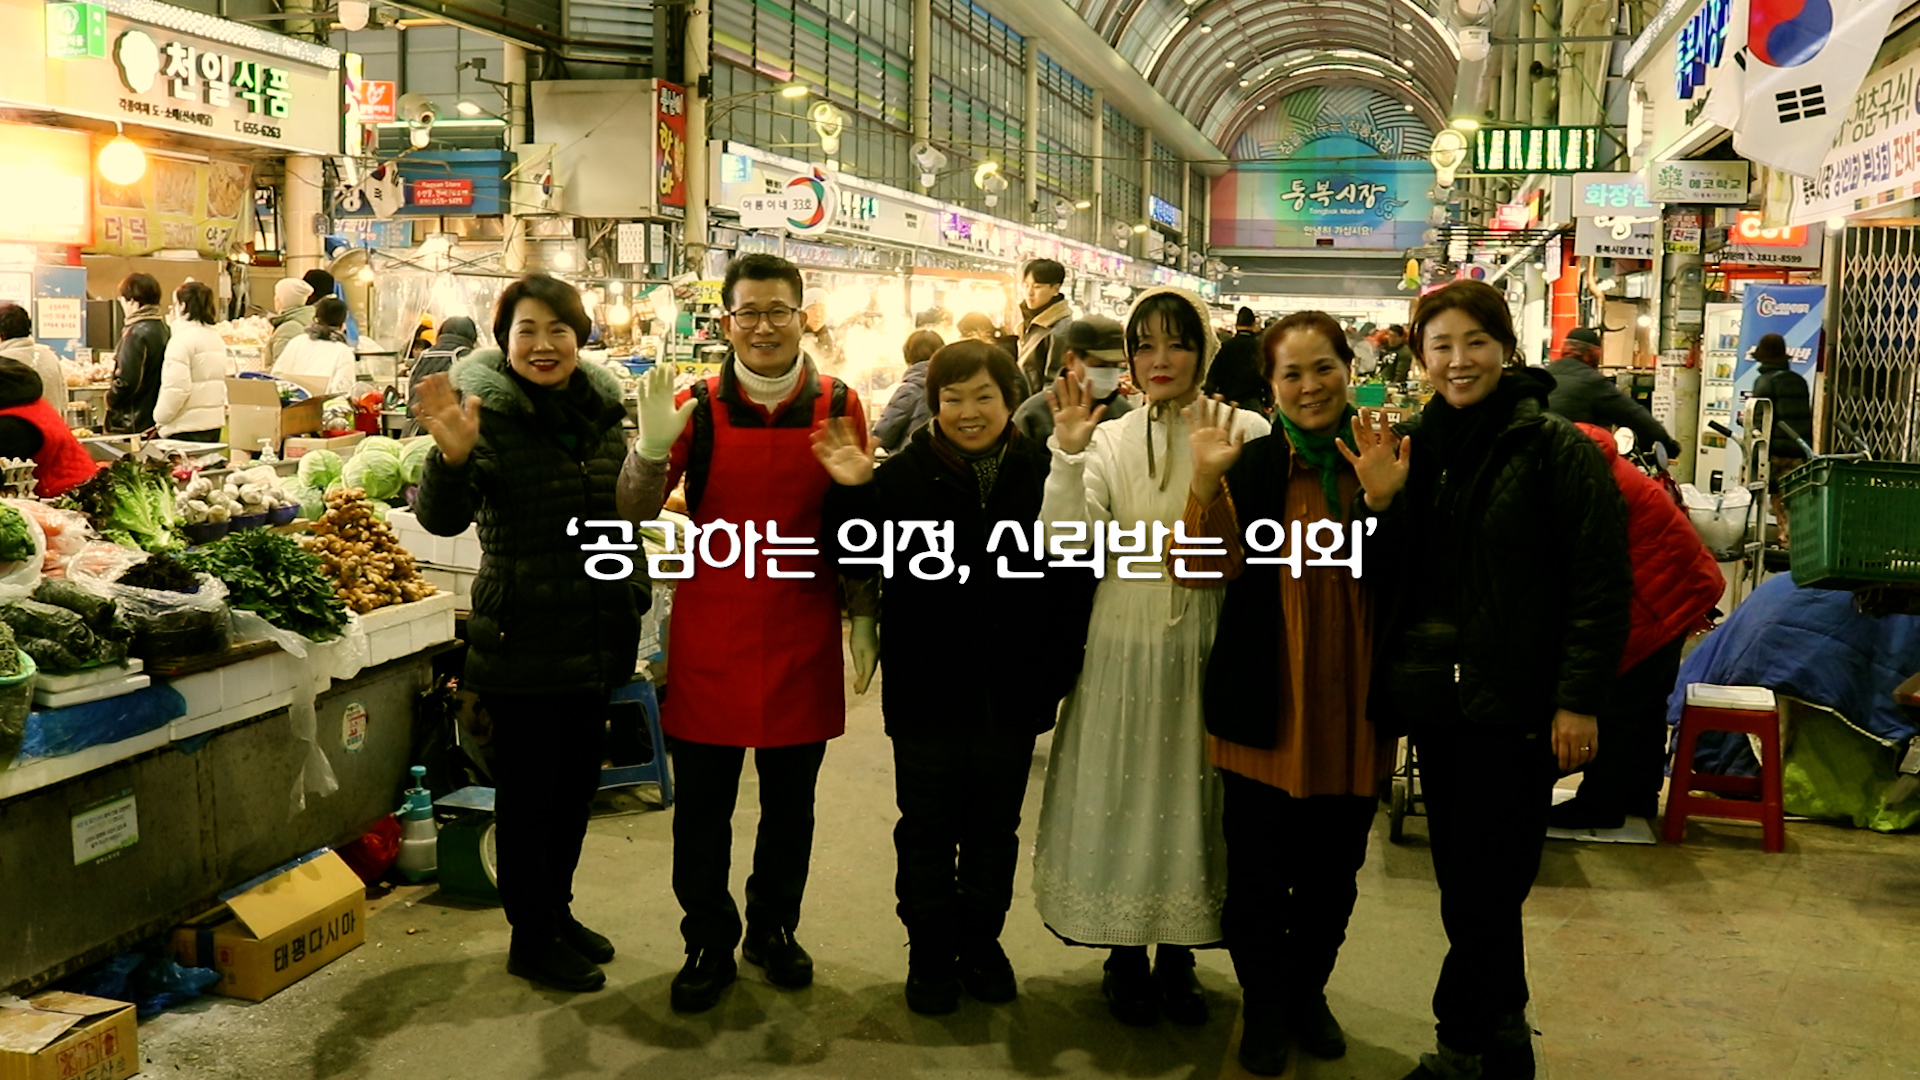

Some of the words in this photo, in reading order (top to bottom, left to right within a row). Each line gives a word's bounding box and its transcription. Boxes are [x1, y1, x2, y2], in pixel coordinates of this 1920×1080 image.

[164, 42, 293, 119] 천일식품
[119, 98, 150, 115] 각종야채
[243, 122, 281, 139] 655-6263
[1834, 153, 1861, 197] 상인회
[1863, 141, 1891, 188] 부녀회
[1894, 127, 1920, 177] 잔치
[1281, 180, 1387, 211] 통복시장
[1585, 184, 1653, 208] 화장실
[1689, 179, 1741, 189] 에코학교
[792, 198, 812, 210] 33호
[104, 216, 148, 248] 더덕
[1303, 225, 1331, 236] 안녕히
[274, 909, 356, 973] 태평다시마
